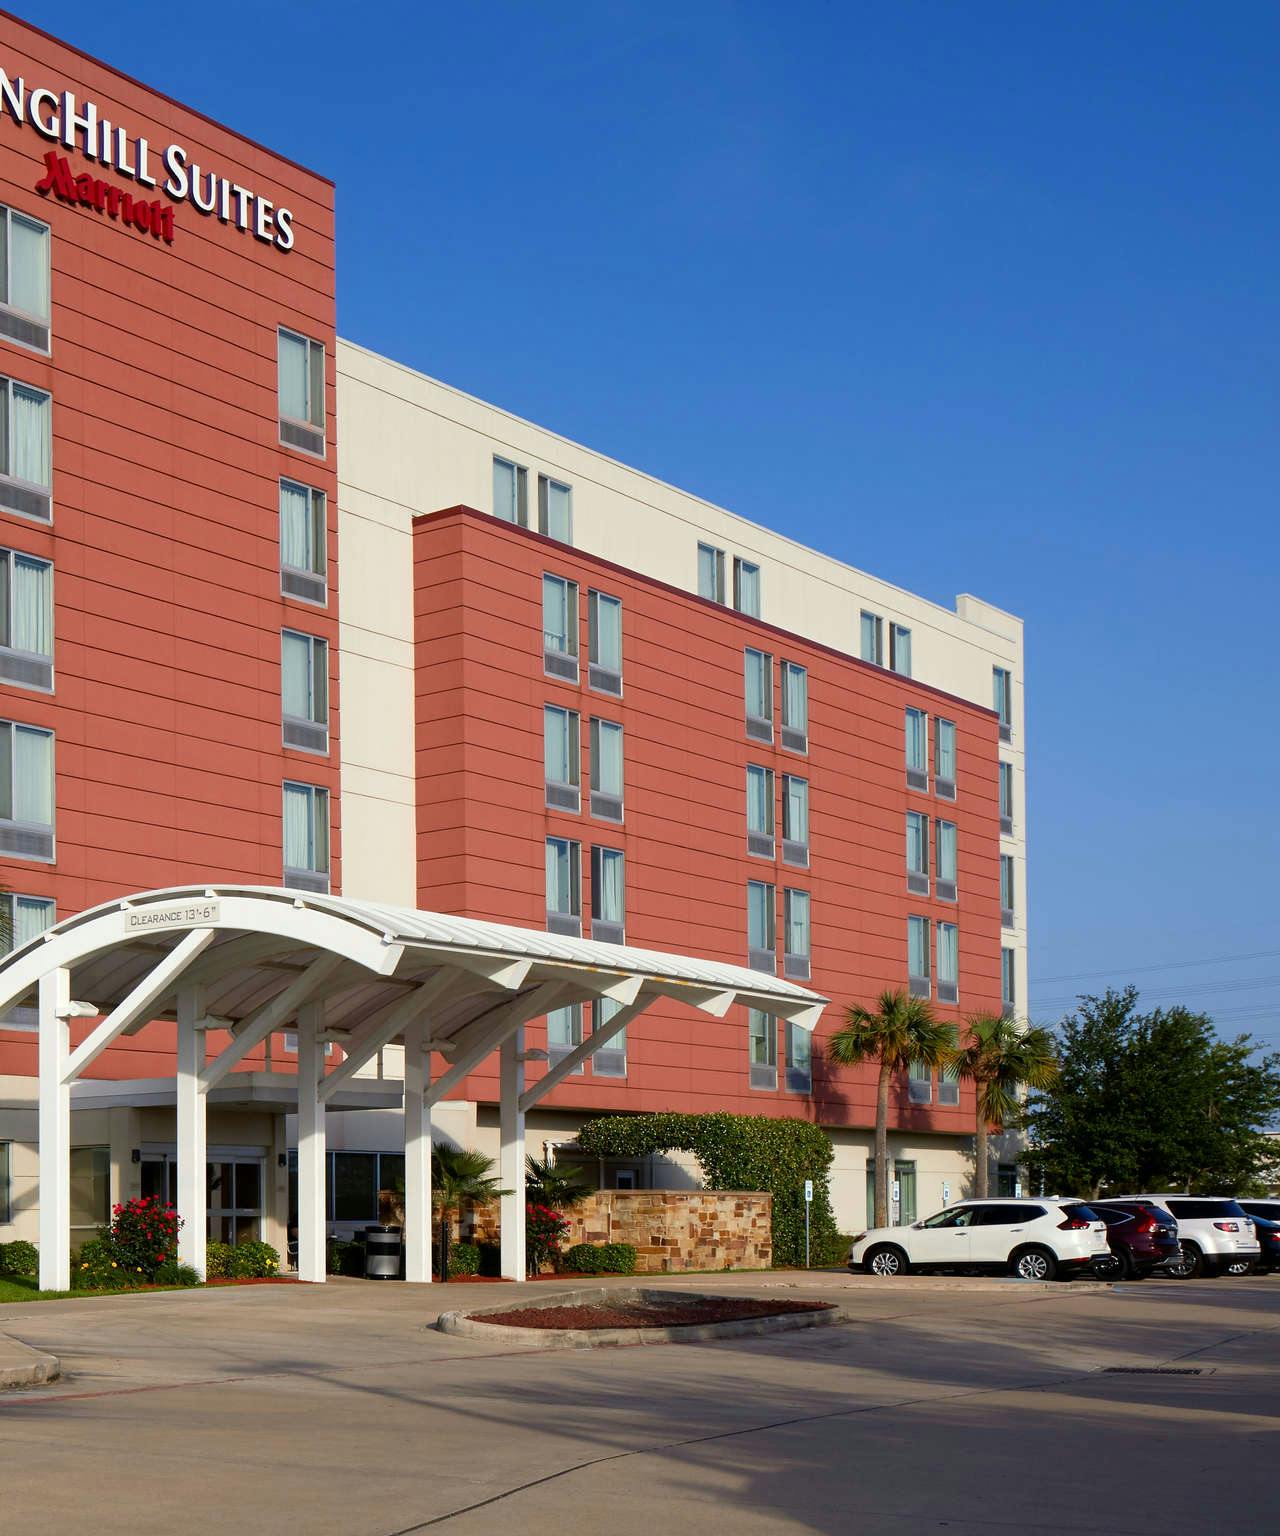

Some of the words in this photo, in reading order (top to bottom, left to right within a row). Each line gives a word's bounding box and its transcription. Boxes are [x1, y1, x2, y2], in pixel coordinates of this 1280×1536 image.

[35, 151, 175, 245] Marriott
[164, 143, 296, 251] SUITES
[130, 911, 182, 926] CLEARANCE
